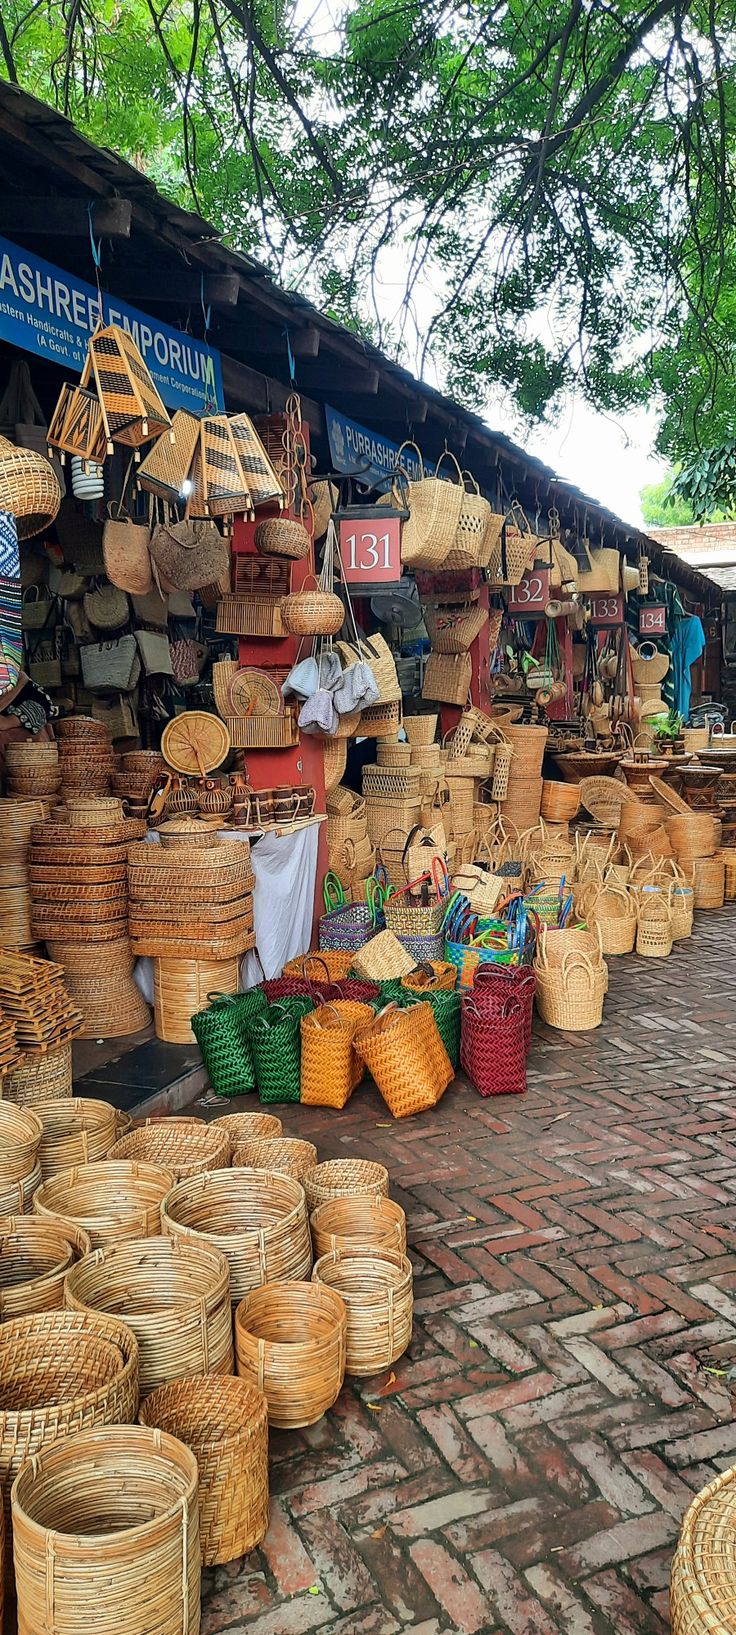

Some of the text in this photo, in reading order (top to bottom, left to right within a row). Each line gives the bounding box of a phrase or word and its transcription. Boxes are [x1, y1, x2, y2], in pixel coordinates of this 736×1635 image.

[26, 312, 74, 344] Handicrafts
[76, 335, 83, 348] &
[37, 333, 47, 347] (A
[48, 339, 71, 358] Govt.
[73, 351, 81, 362] of
[345, 533, 394, 570] 131
[510, 578, 543, 604] 132
[591, 598, 618, 618] 133
[640, 613, 663, 629] 134
